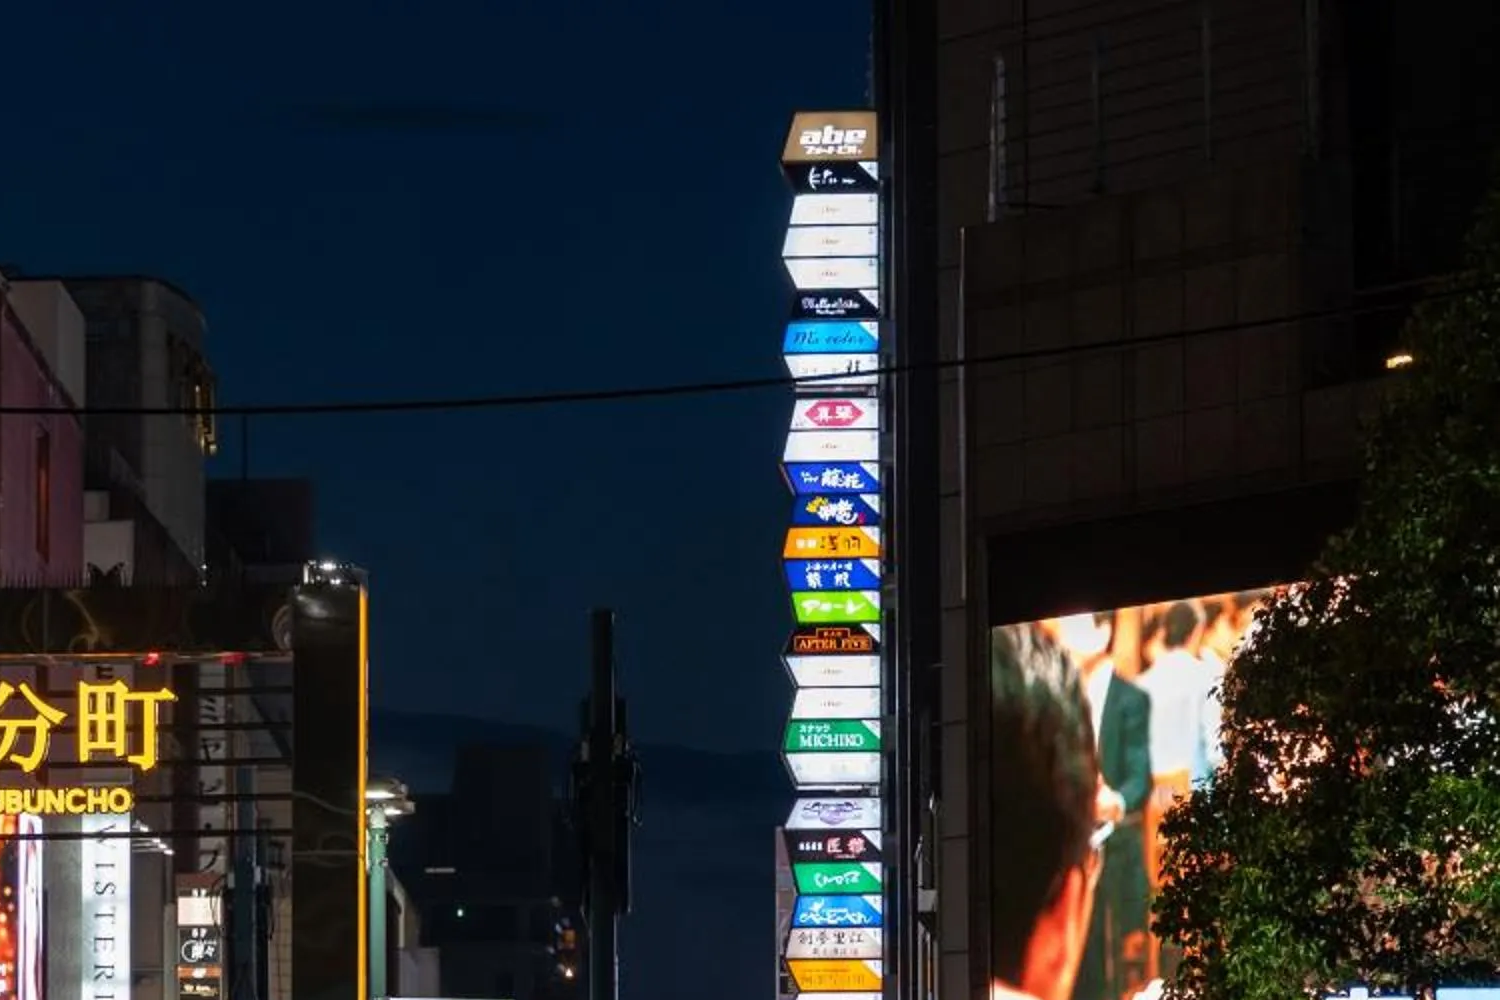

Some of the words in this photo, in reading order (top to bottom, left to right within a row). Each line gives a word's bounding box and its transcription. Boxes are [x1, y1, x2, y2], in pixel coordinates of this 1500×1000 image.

[799, 124, 867, 145] abe
[799, 724, 832, 734] スナック
[799, 734, 866, 748] MICHIKO
